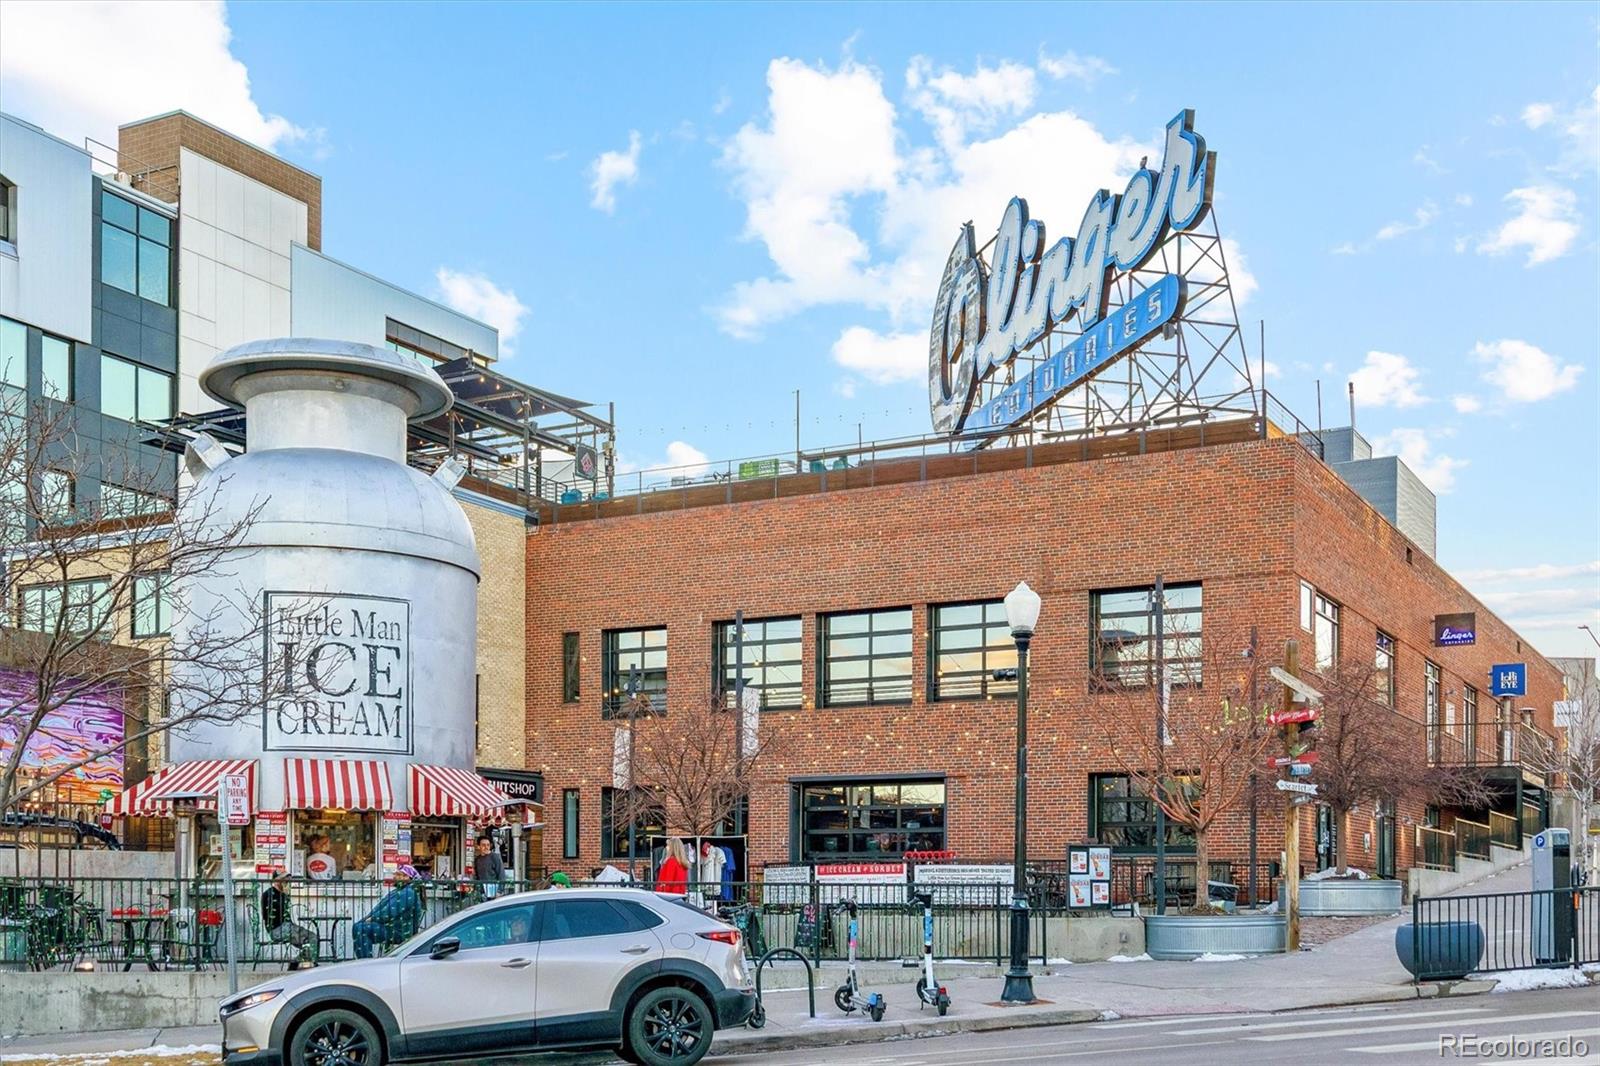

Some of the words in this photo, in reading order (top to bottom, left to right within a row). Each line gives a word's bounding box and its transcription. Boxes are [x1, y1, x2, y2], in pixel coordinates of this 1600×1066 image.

[277, 605, 343, 637] Little
[350, 608, 402, 641] Man
[277, 641, 403, 699] ICE
[276, 700, 403, 739] CREAM
[227, 787, 247, 798] PARKING
[231, 777, 241, 787] NO
